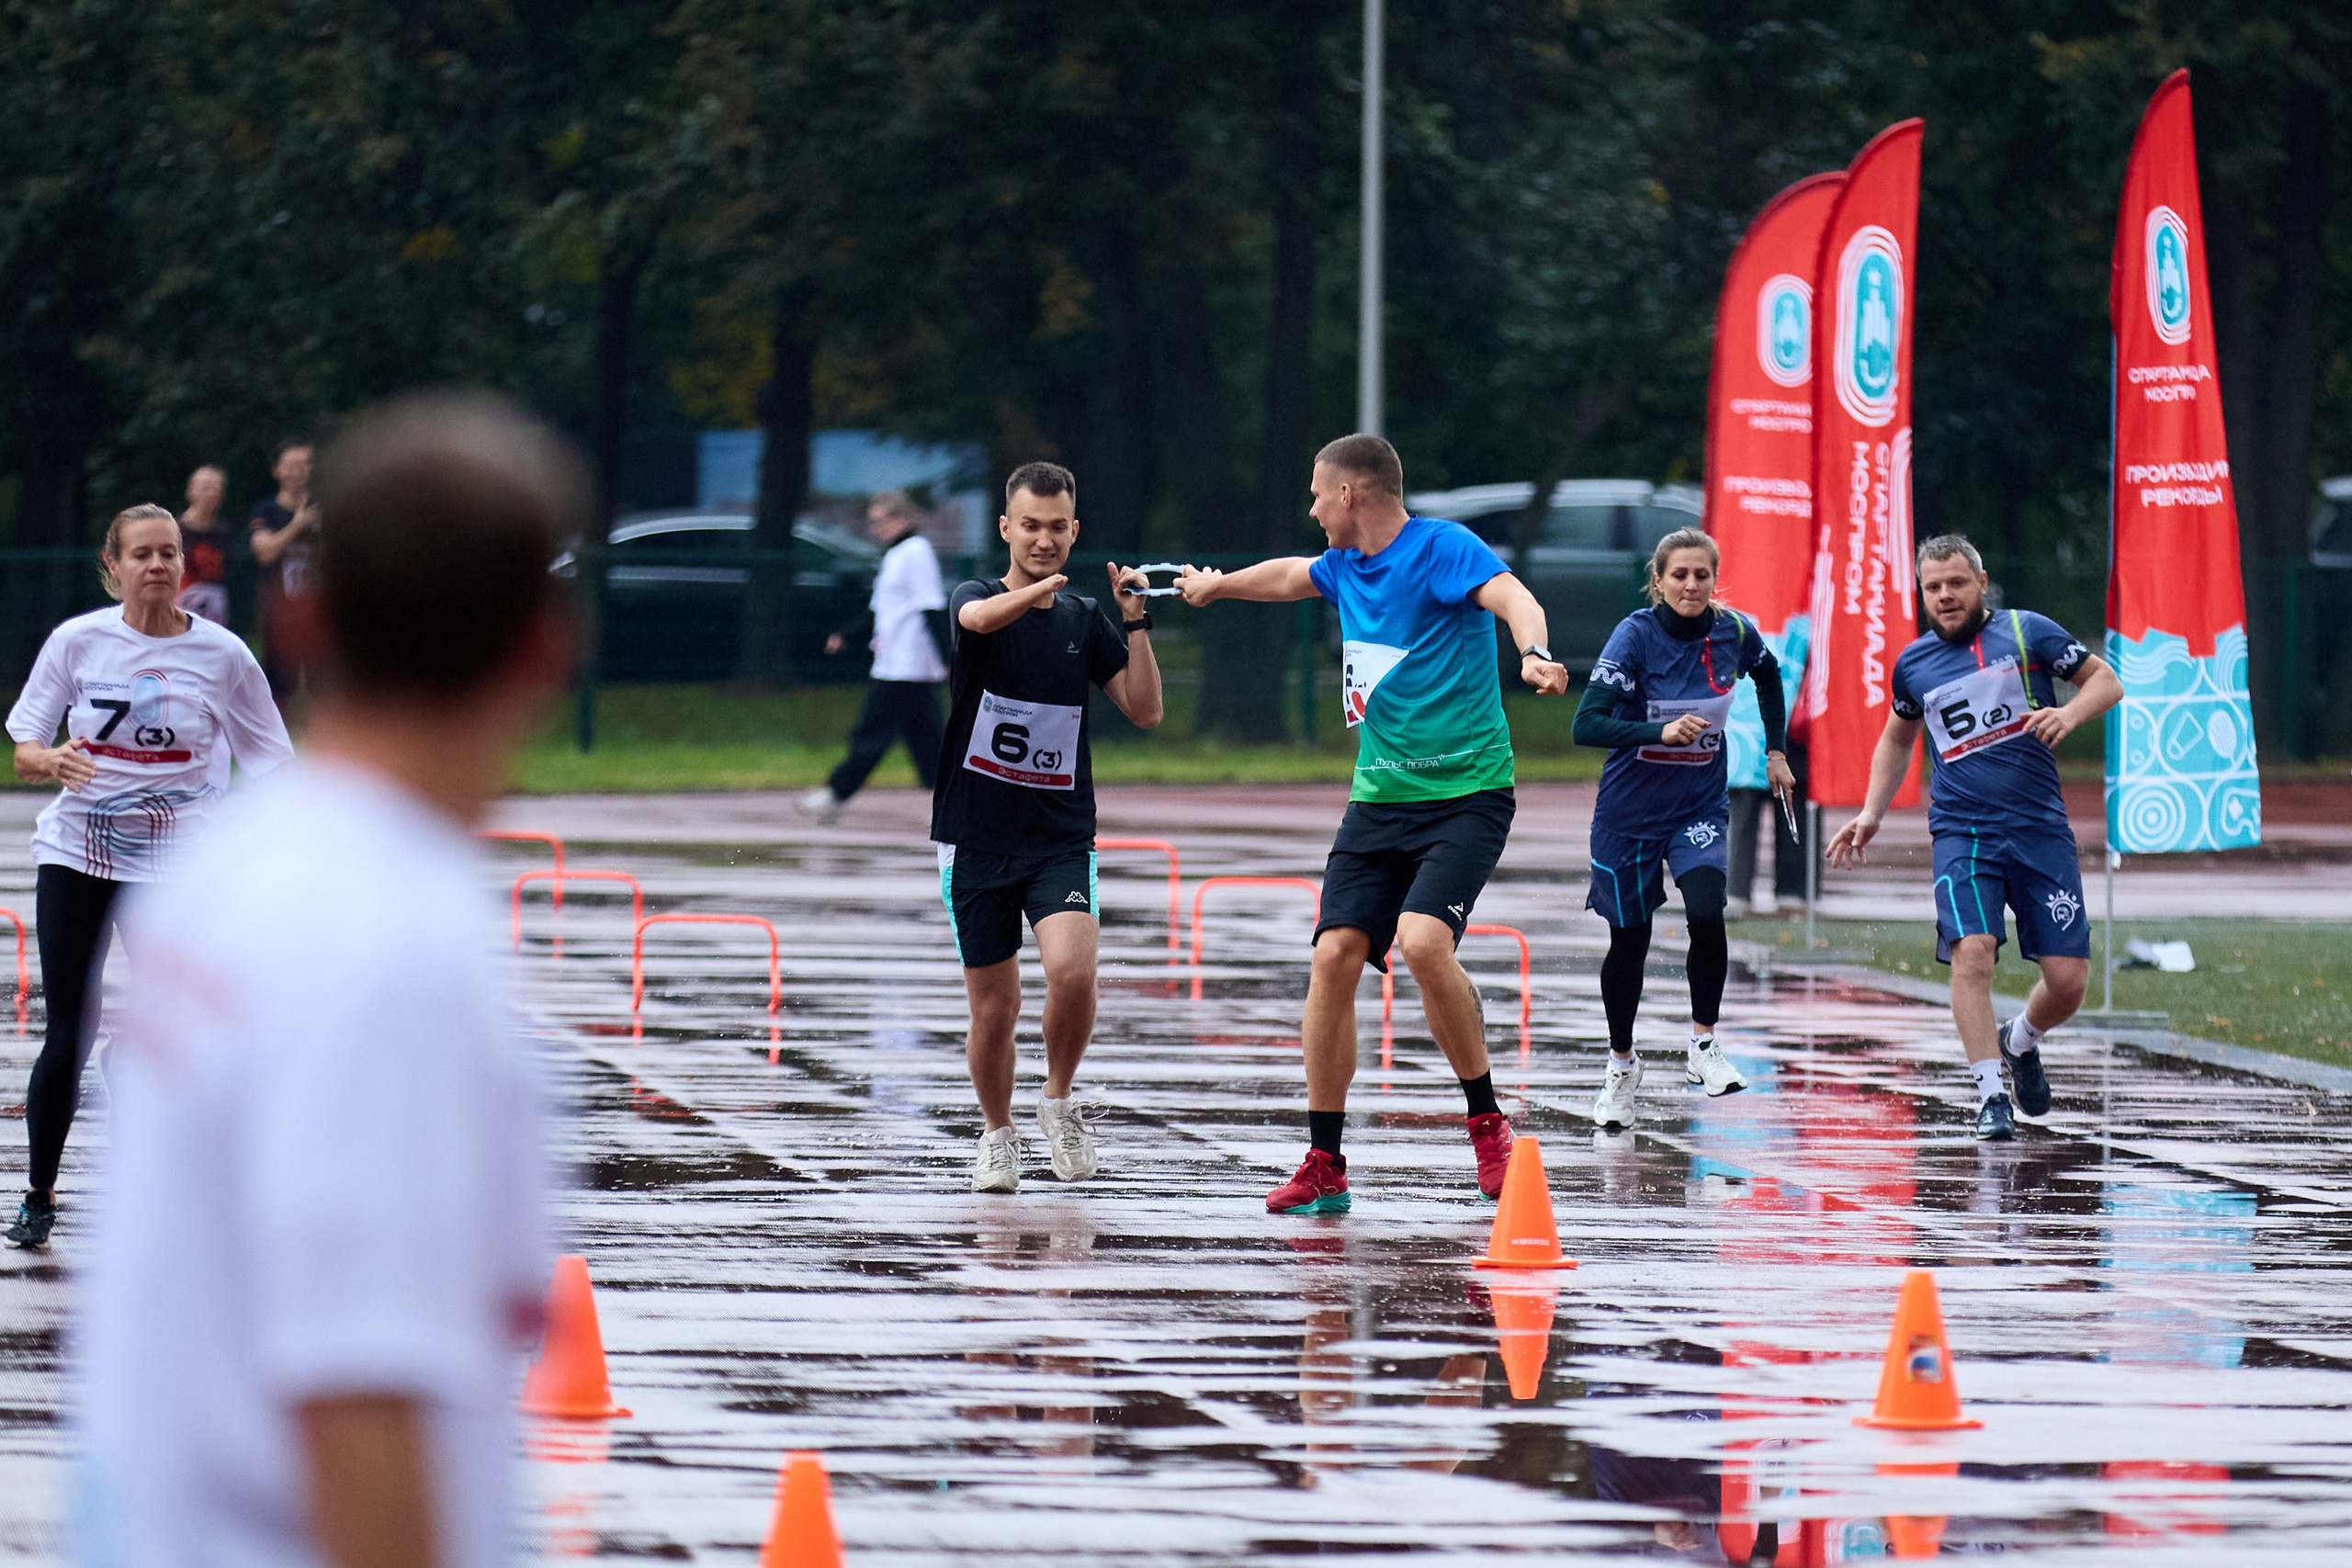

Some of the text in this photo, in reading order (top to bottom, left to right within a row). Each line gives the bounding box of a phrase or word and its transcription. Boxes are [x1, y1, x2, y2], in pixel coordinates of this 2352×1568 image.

[1844, 441, 1871, 615] МОСПРОМ
[1861, 441, 1890, 708] СПАРТАКИАДА
[90, 698, 130, 741] 7
[135, 725, 175, 748] (3)
[1939, 699, 2012, 739] 5 (2)
[991, 722, 1062, 771] 6 (3)
[1961, 729, 2007, 751] Эстафета
[998, 766, 1050, 783] Эстафета
[1374, 757, 1440, 770] ПУЛЬС ДОБРА
